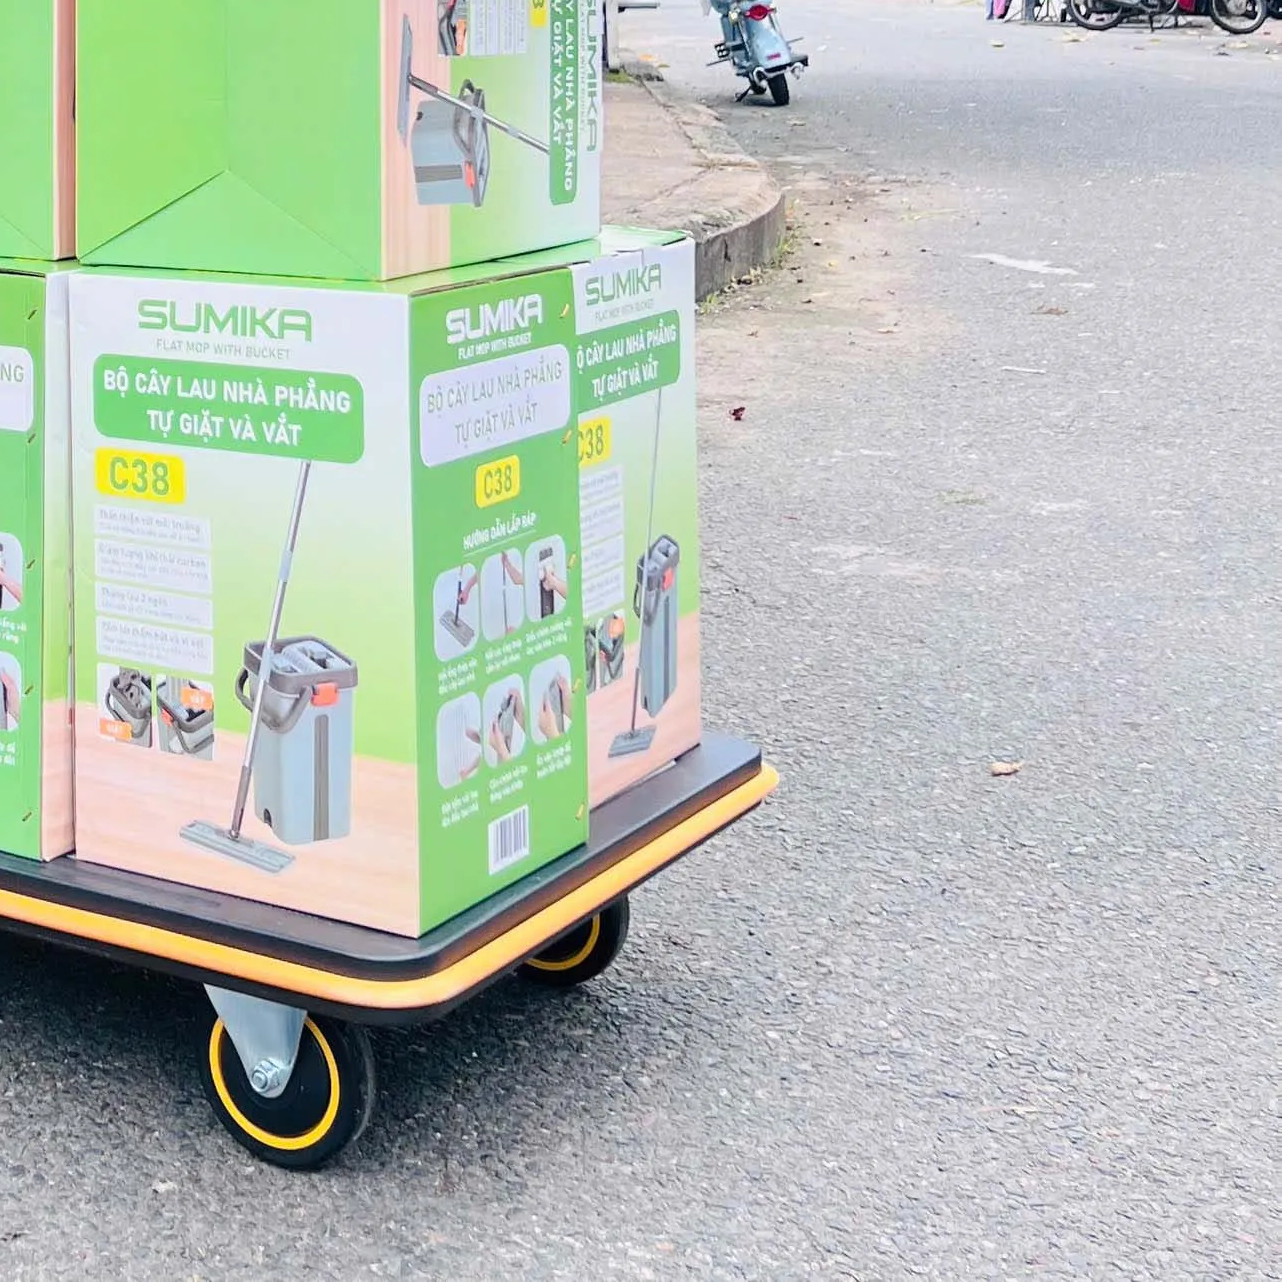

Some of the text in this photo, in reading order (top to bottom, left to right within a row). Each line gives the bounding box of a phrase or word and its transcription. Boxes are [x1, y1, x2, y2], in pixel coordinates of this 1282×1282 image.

[586, 263, 662, 306] SUMIKA
[137, 299, 313, 342] SUMIKA
[446, 294, 543, 345] SUMIKA
[156, 338, 291, 361] FLAT MOP WITH BUCKET
[458, 332, 532, 360] FLAT MOP WITH BUCKET
[577, 344, 584, 374] Ộ
[103, 366, 351, 414] BỘ CÂY LAU NHÀ PHẲNG
[147, 410, 303, 446] TỰ GIẶT VÀ VẮT
[109, 455, 170, 497] C38
[484, 465, 512, 499] C38
